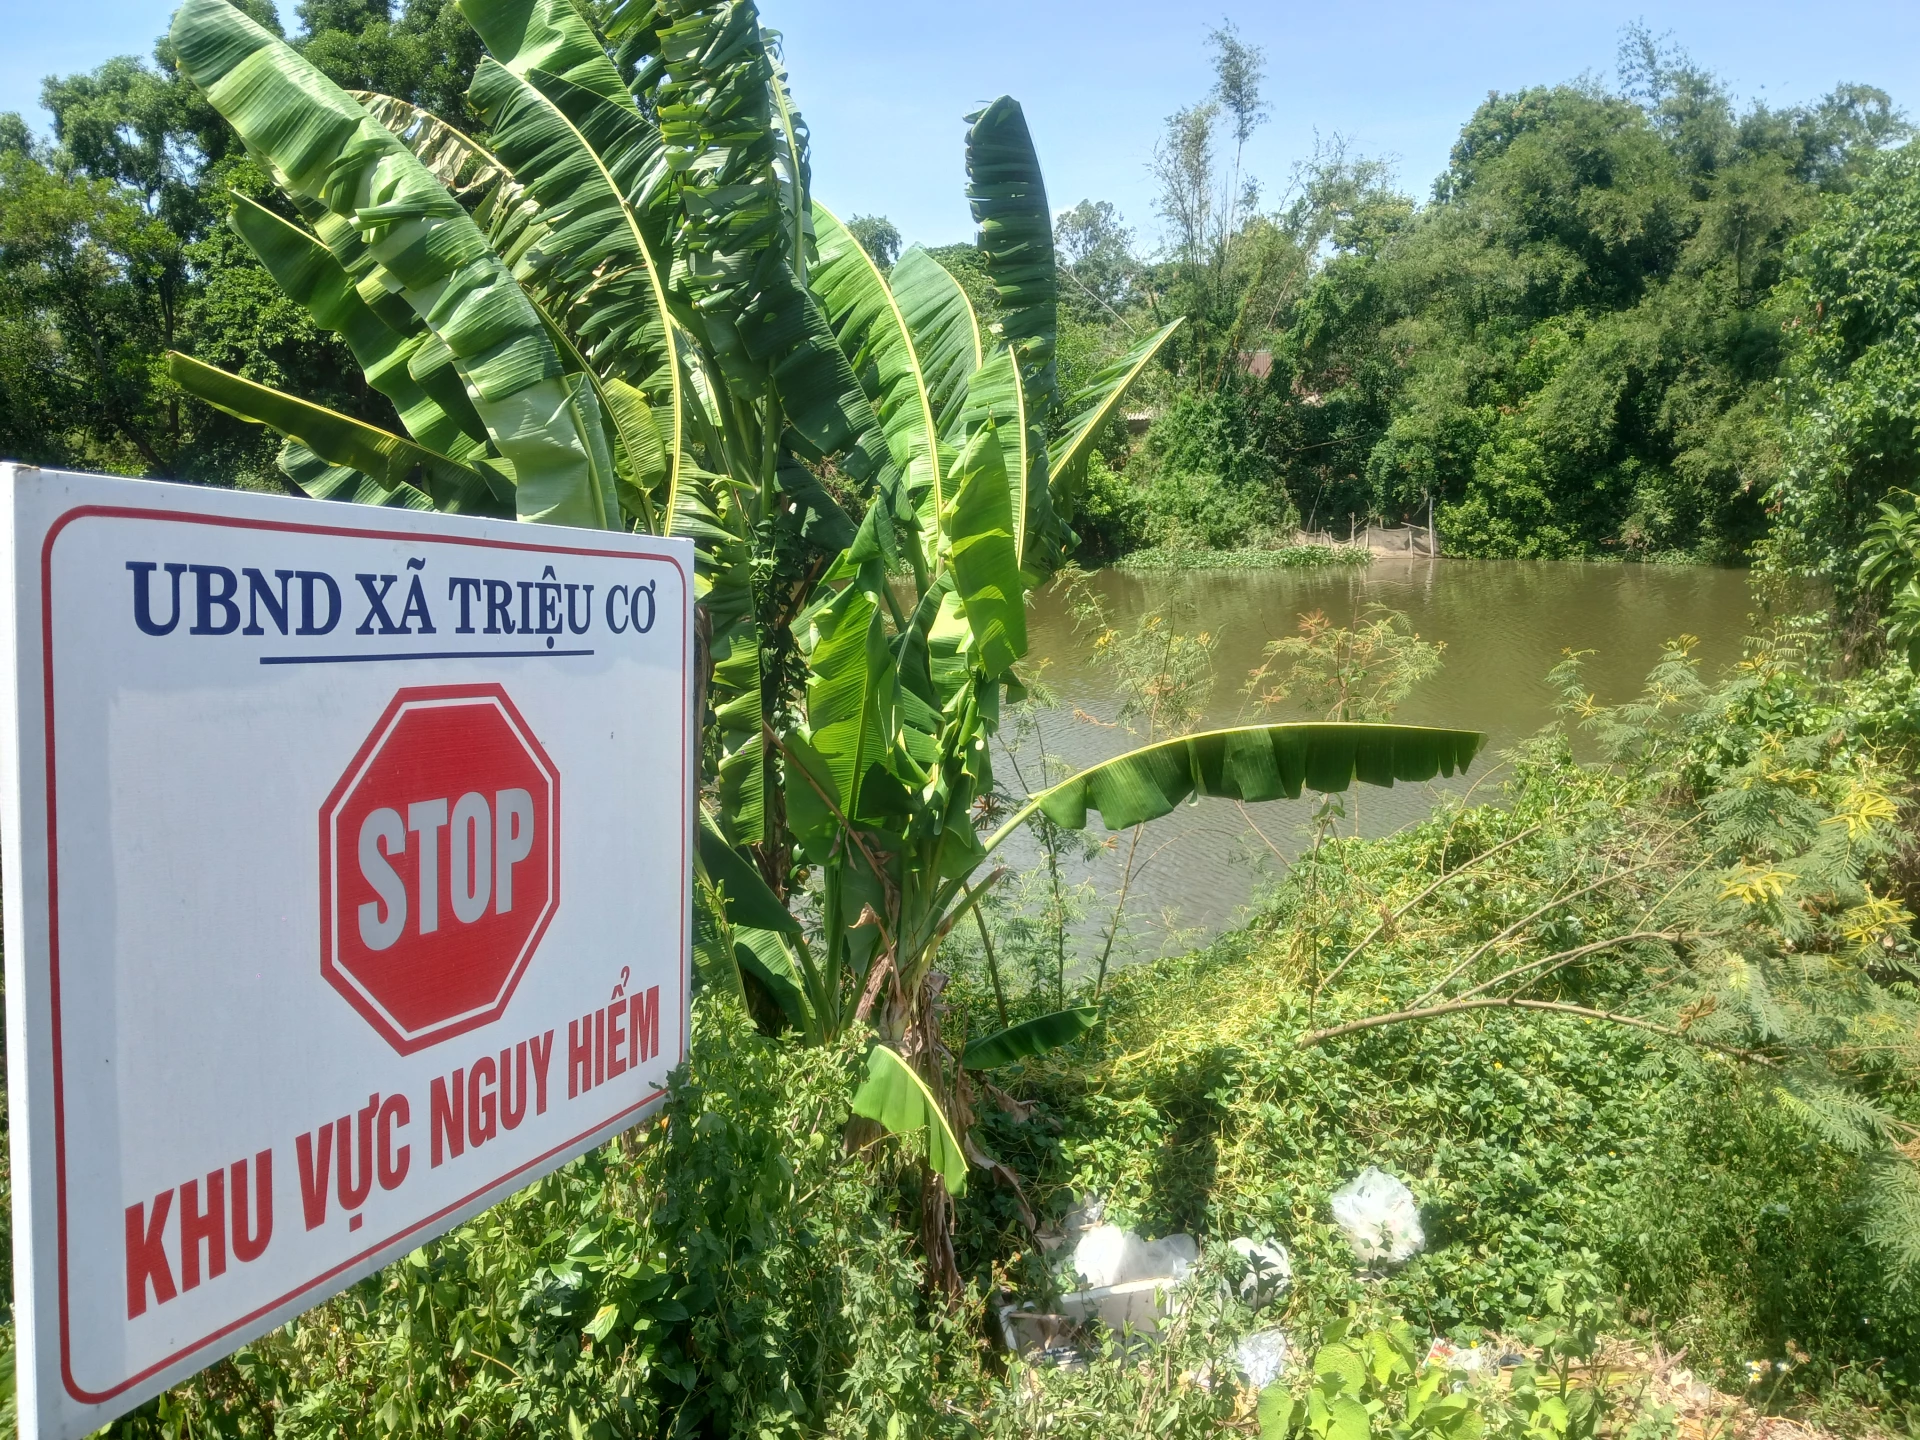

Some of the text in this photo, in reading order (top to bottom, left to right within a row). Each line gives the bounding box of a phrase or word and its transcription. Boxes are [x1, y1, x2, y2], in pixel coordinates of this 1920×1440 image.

[126, 558, 656, 650] UBND XÃ TRIỆU CƠ
[357, 787, 535, 951] STOP
[126, 966, 660, 1320] KHU VỰC NGUY HIỂM
